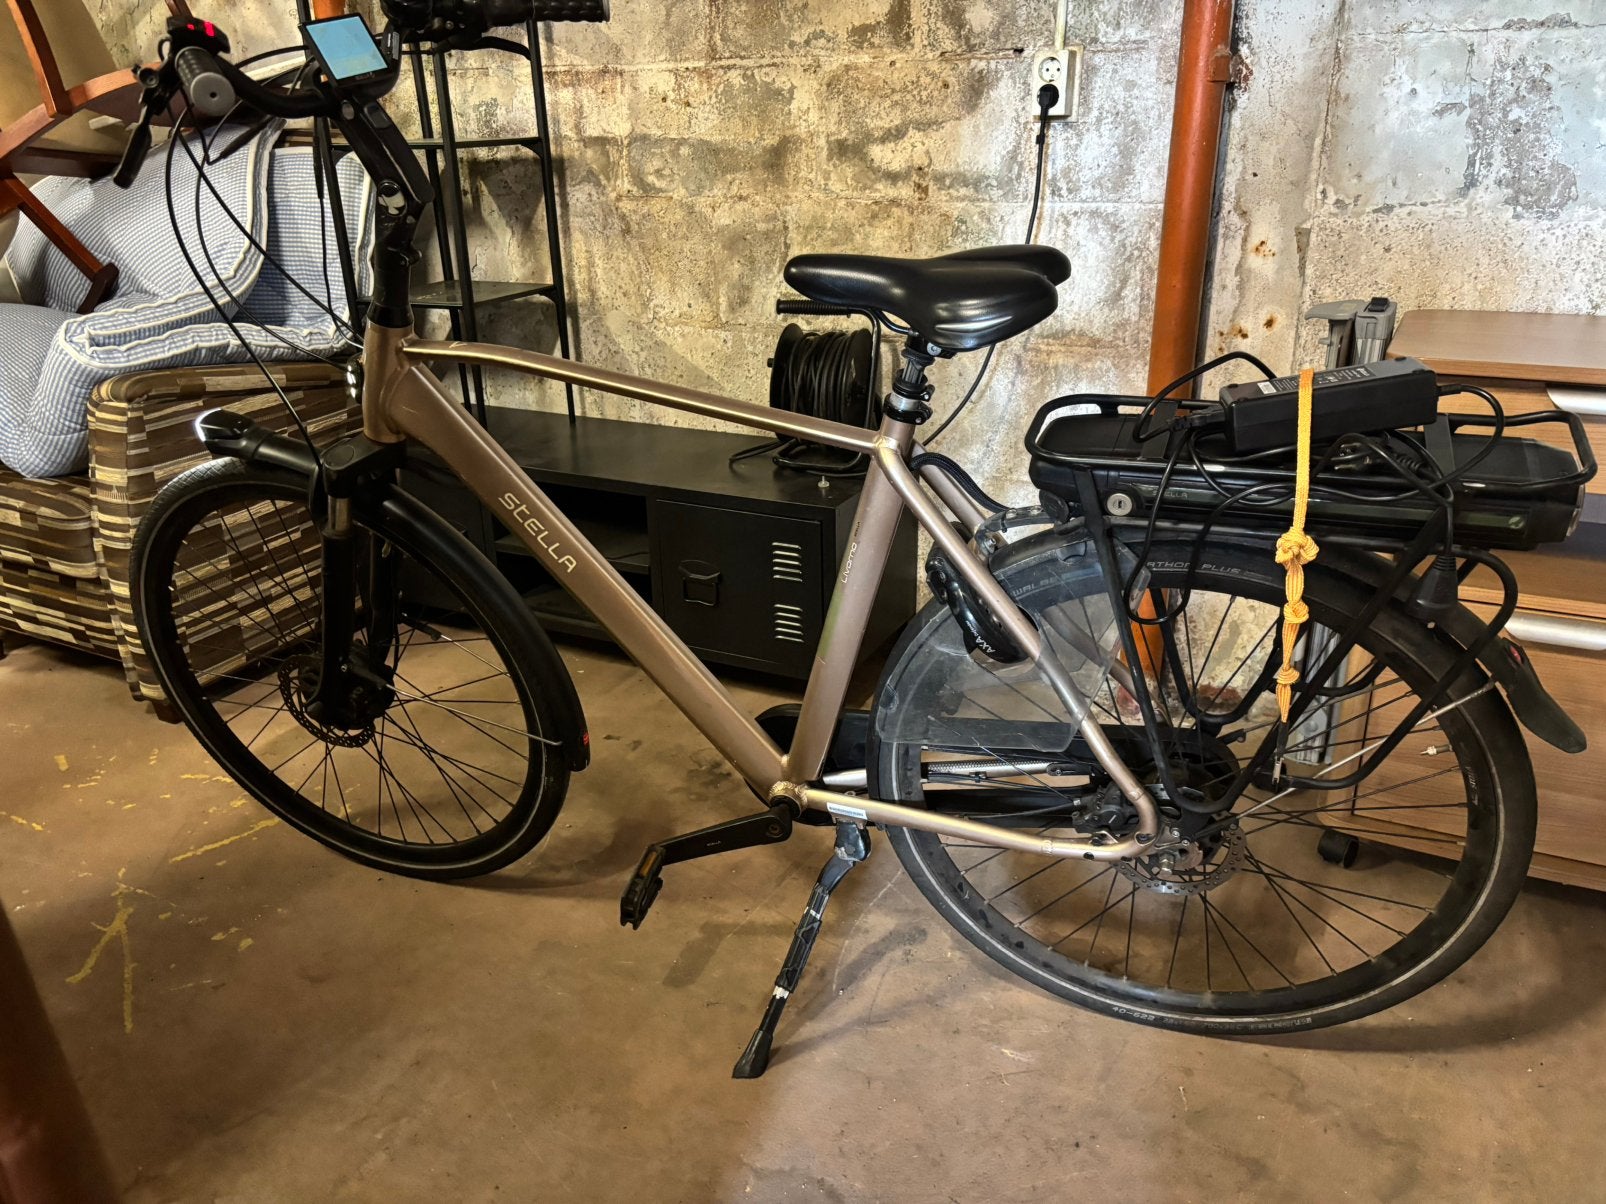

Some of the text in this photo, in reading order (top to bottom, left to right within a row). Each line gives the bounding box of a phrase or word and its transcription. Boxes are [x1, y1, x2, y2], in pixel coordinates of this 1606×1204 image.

[1152, 489, 1188, 499] SELLA
[498, 492, 577, 573] STELLA
[1146, 561, 1241, 574] ATHO PLUS
[975, 636, 996, 653] AXA
